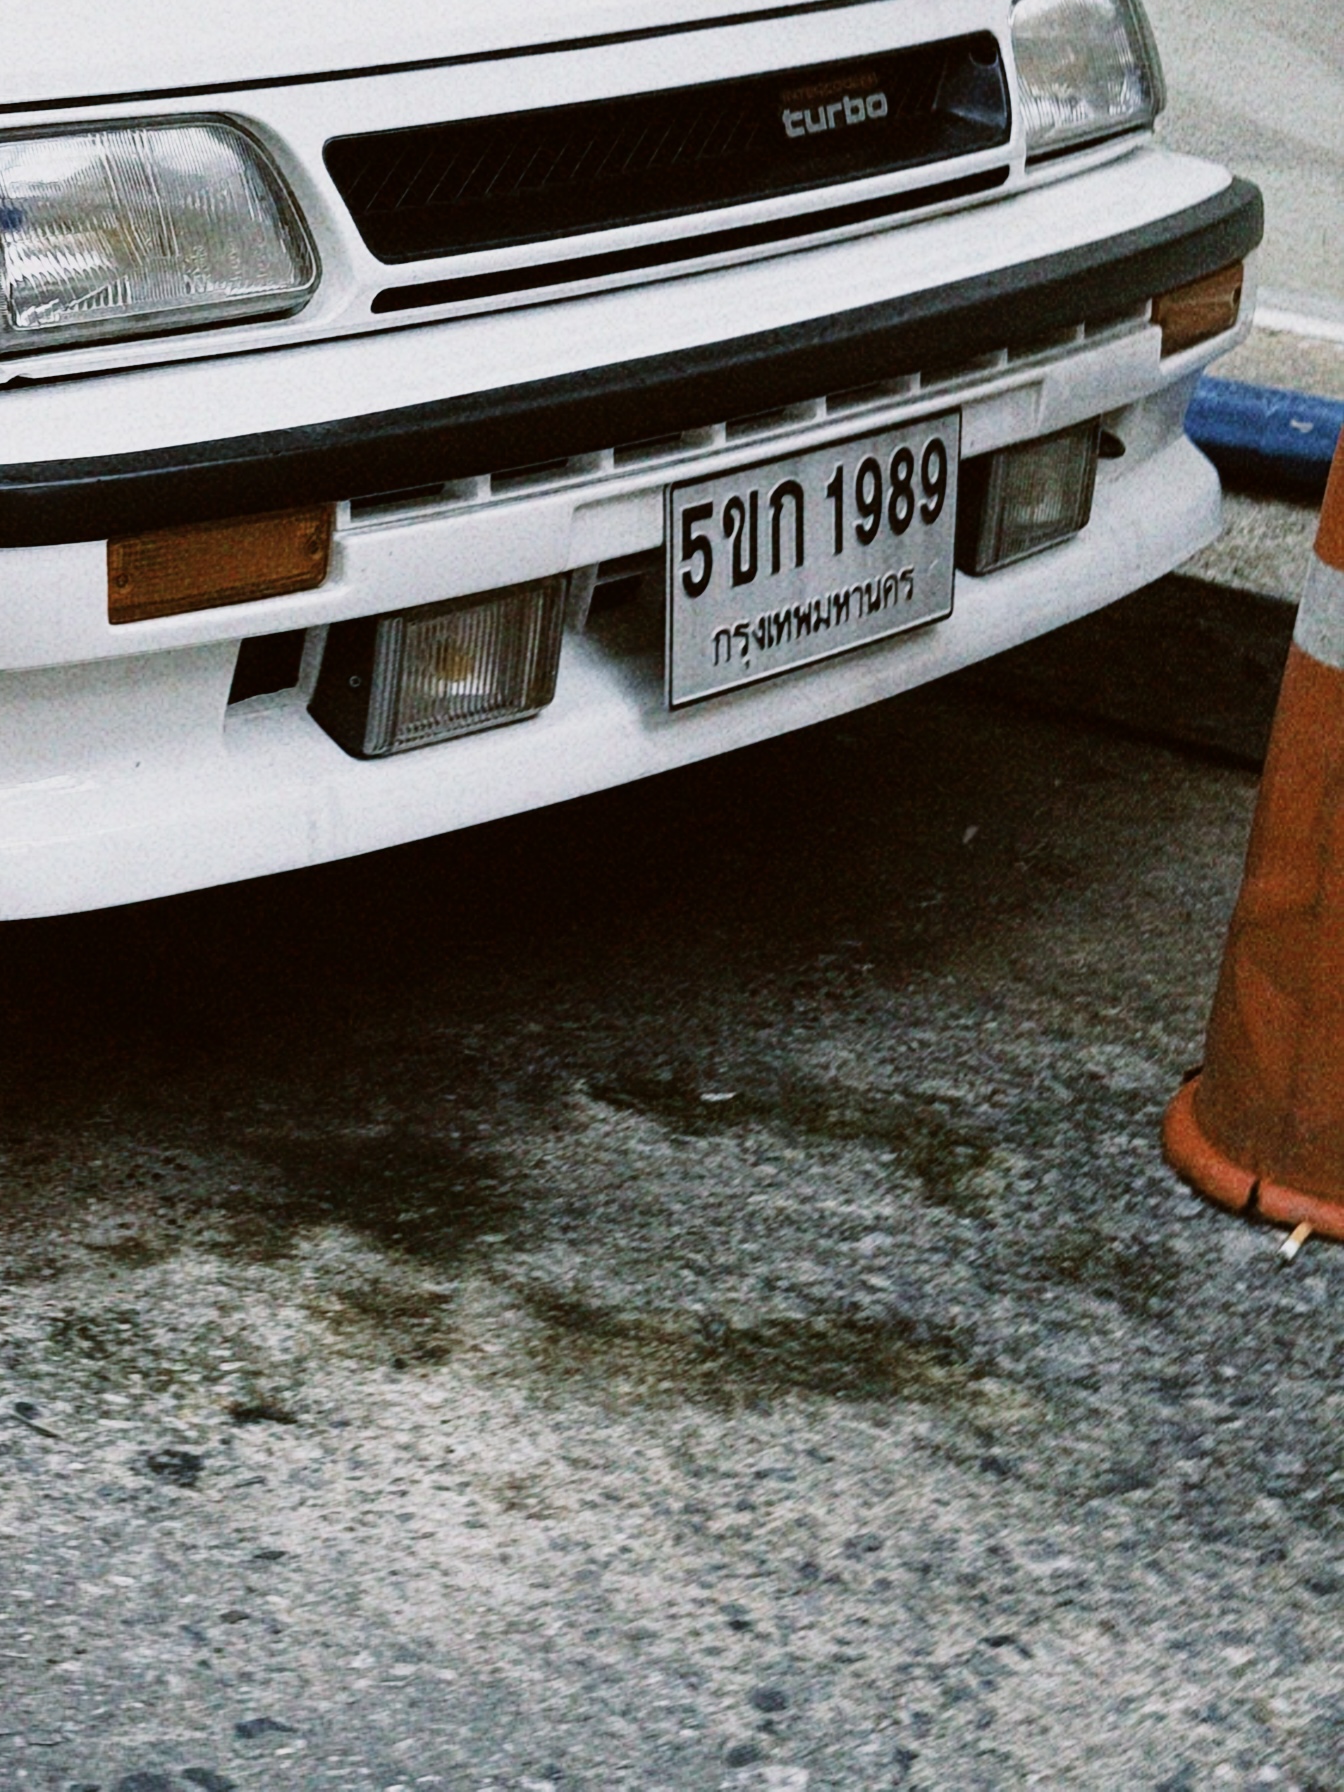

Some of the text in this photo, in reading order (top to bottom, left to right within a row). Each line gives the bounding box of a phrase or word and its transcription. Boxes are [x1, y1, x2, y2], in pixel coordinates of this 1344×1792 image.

[782, 92, 888, 138] turbo
[678, 437, 948, 599] 5ขก 1989
[711, 564, 915, 669] กรุงเทพมหานคร
